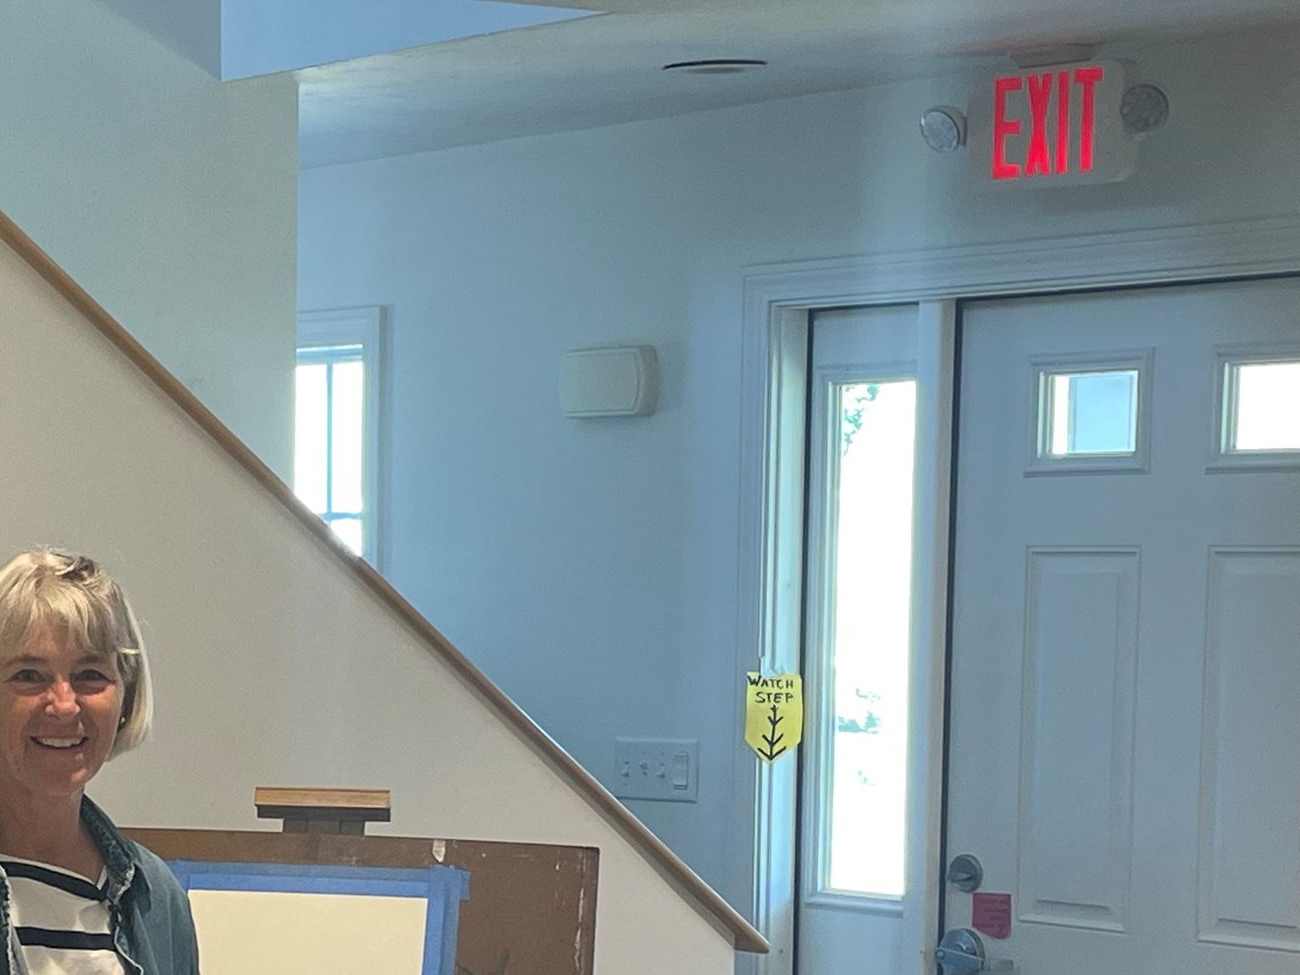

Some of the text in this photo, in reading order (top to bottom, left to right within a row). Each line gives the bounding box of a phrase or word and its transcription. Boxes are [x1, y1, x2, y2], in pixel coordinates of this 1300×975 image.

[992, 66, 1104, 180] EXIT
[747, 674, 794, 689] WATCH
[755, 691, 794, 703] STEP
